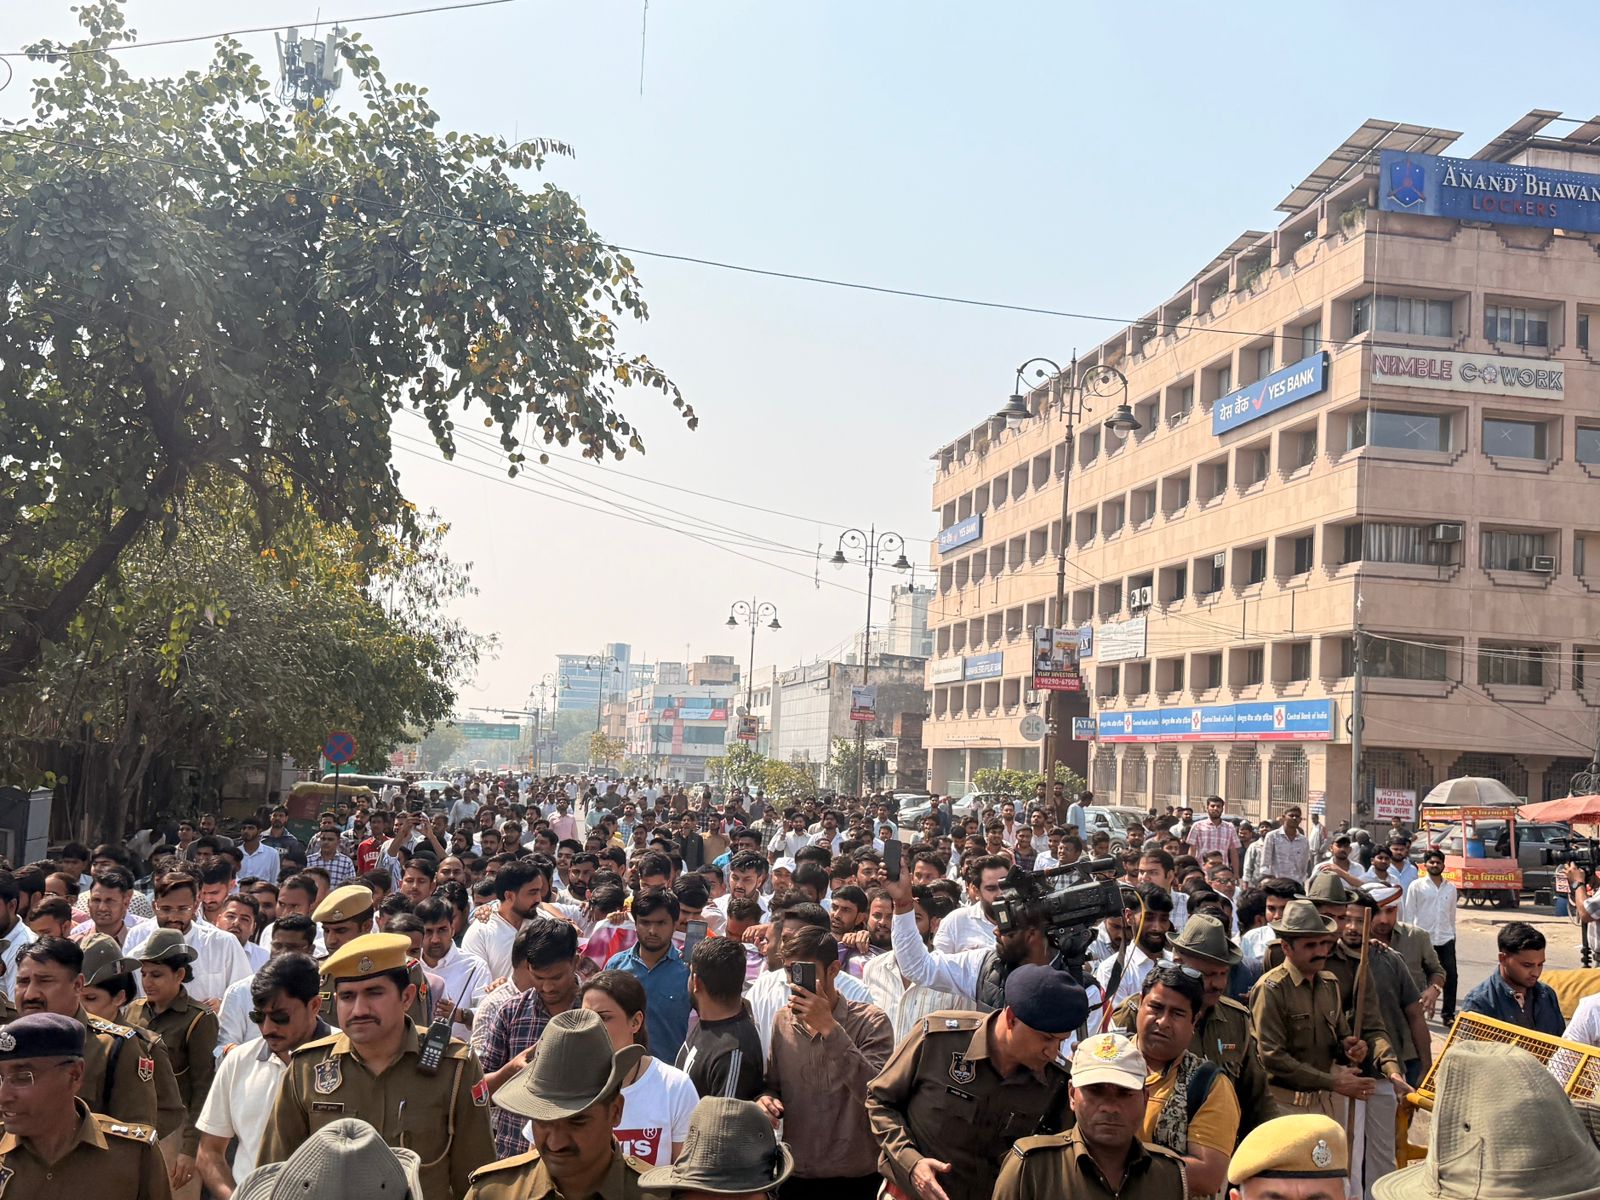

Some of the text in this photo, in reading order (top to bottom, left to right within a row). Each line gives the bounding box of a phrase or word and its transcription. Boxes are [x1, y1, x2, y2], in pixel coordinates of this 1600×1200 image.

[1442, 166, 1517, 193] ANAND
[1472, 195, 1558, 217] LOCKERS
[1373, 353, 1453, 381] NIMBLE
[1268, 367, 1315, 400] YES BANK
[1219, 394, 1250, 421] येस बैंक
[1286, 712, 1300, 720] Central
[1301, 711, 1311, 720] Bank
[1316, 711, 1328, 719] India
[1075, 720, 1096, 729] ATM
[1376, 796, 1414, 807] MARU CASA
[1381, 789, 1406, 798] HOTEL
[1464, 871, 1515, 881] वेज बिरयानी
